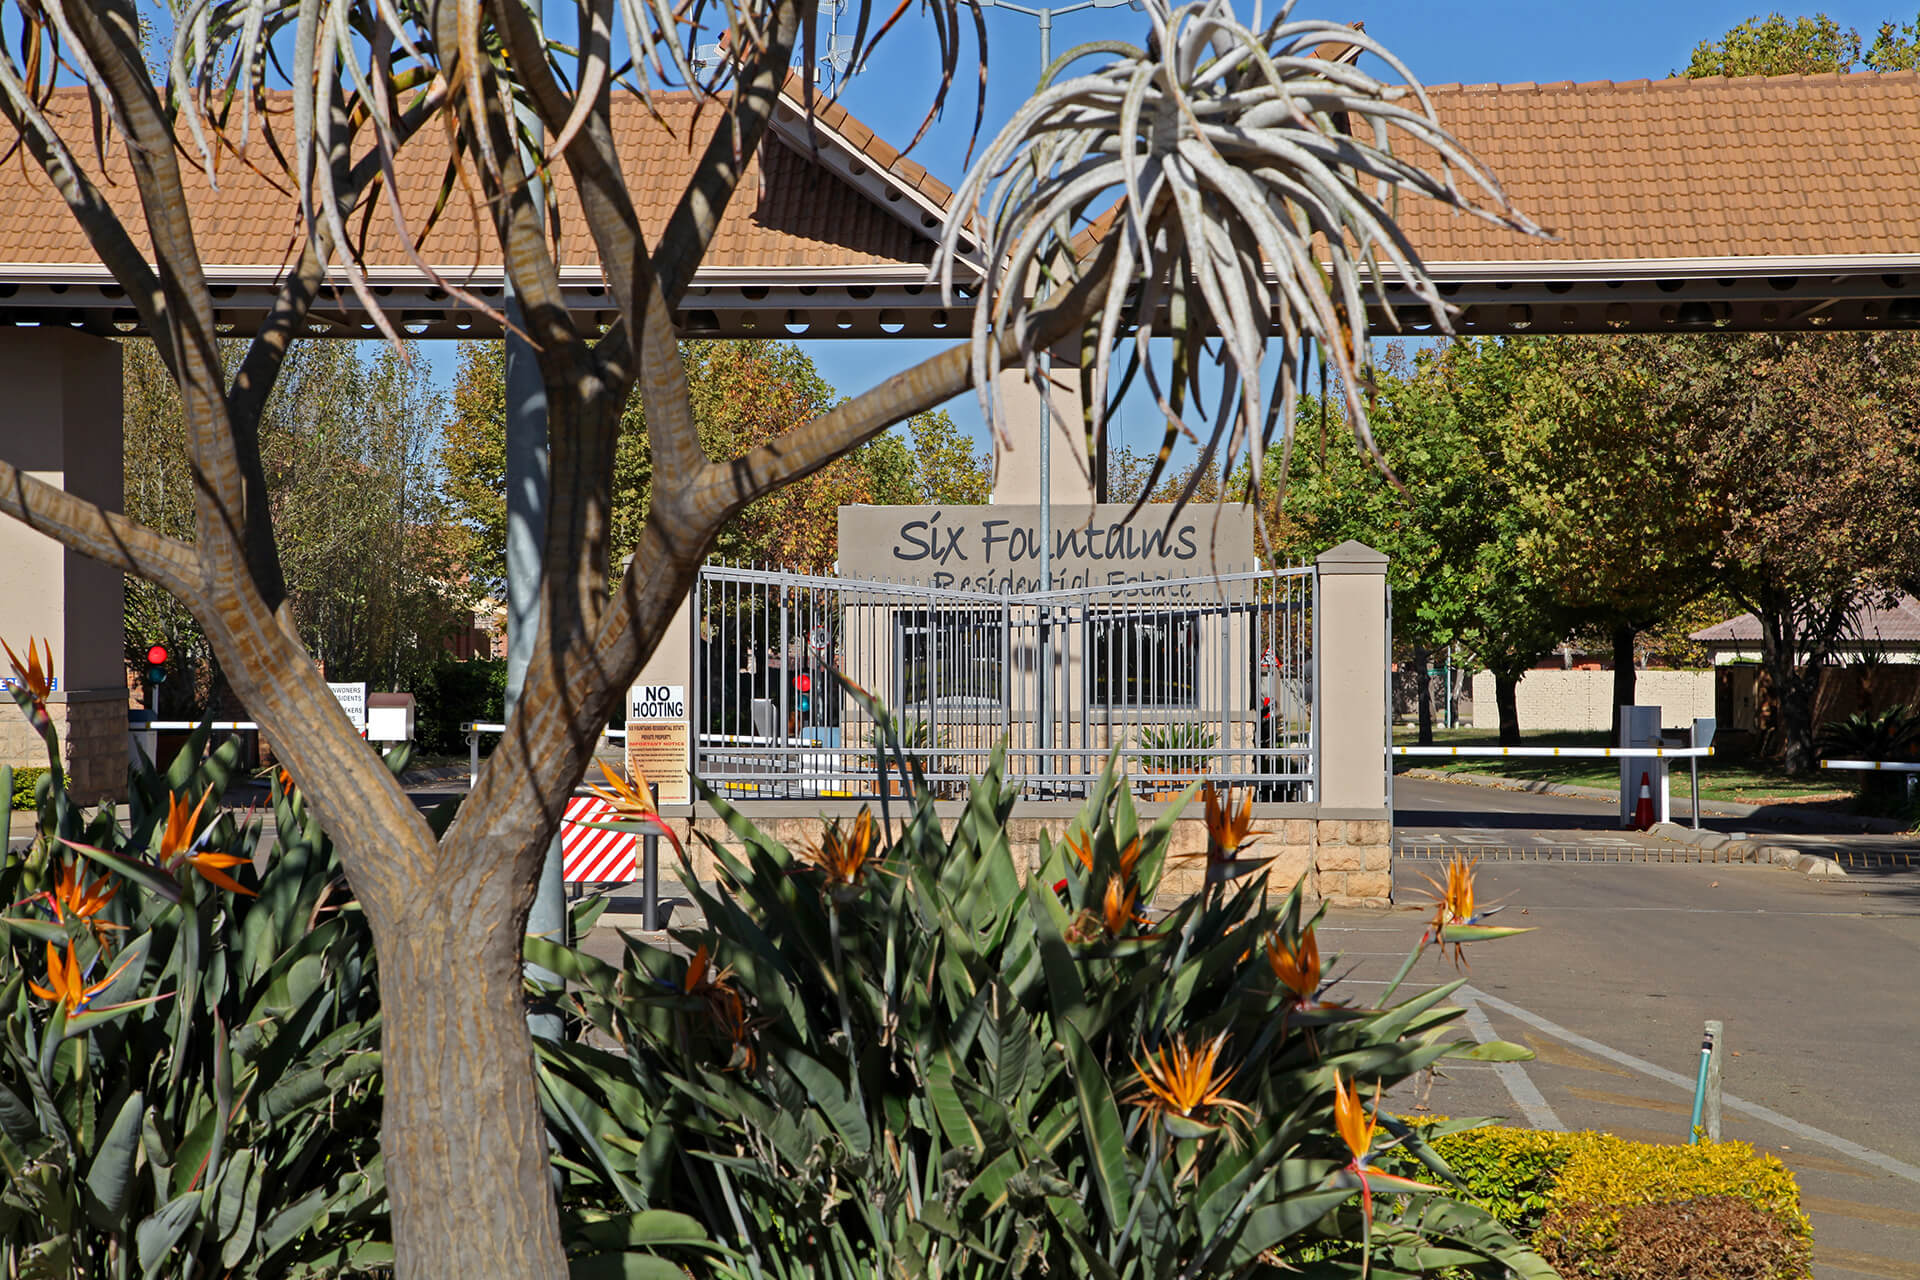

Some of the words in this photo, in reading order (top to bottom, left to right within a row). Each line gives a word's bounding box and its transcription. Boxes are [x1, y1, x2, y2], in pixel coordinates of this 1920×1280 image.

[981, 519, 1197, 564] Fountains
[645, 686, 671, 702] NO
[632, 702, 684, 718] HOOTING
